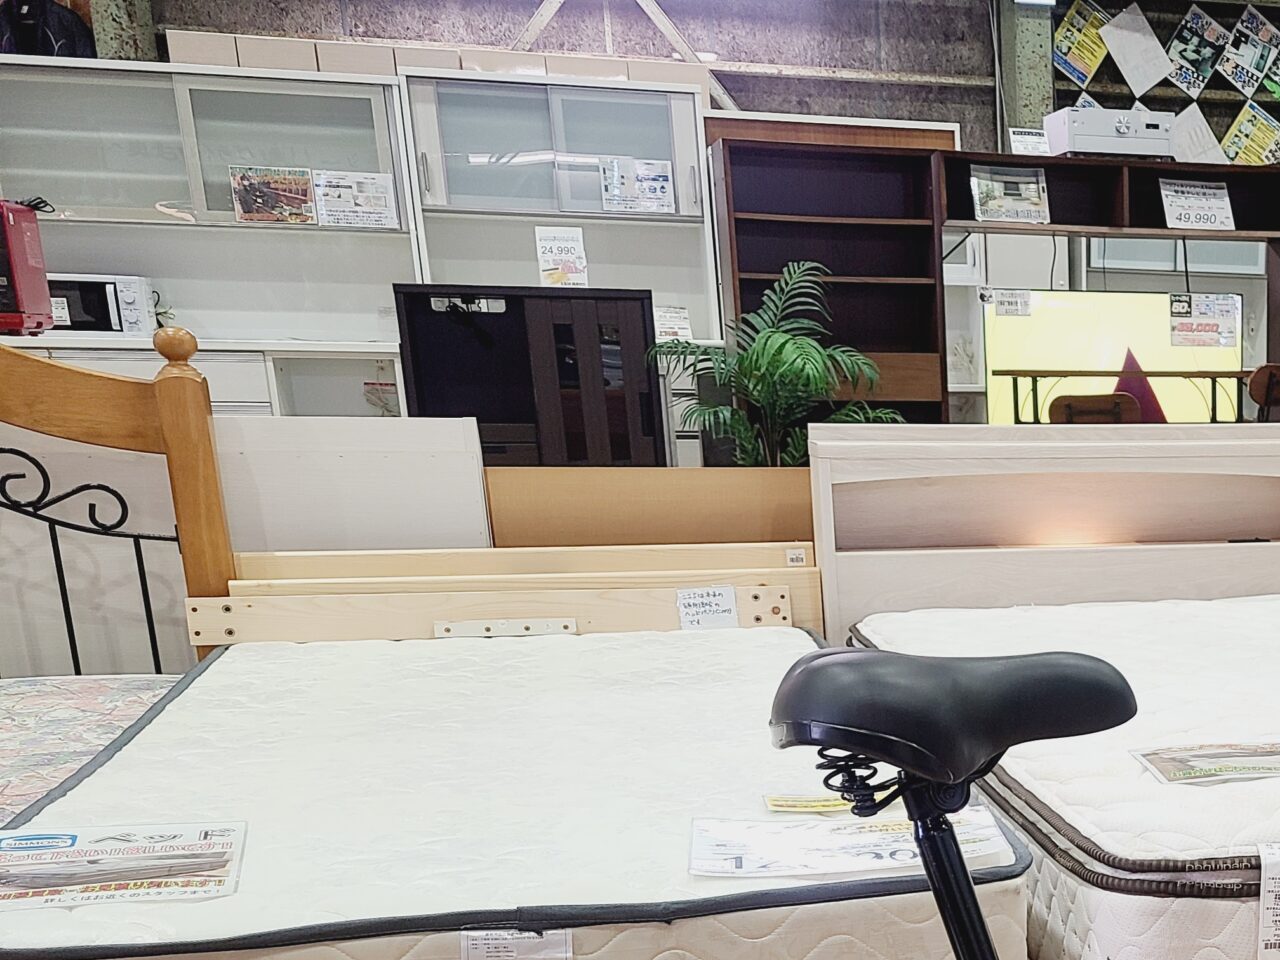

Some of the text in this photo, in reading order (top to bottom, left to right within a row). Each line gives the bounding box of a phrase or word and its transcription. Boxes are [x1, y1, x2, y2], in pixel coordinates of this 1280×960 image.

[1175, 212, 1217, 225] 49,990
[541, 245, 576, 257] 24,990
[89, 828, 236, 845] ベッド
